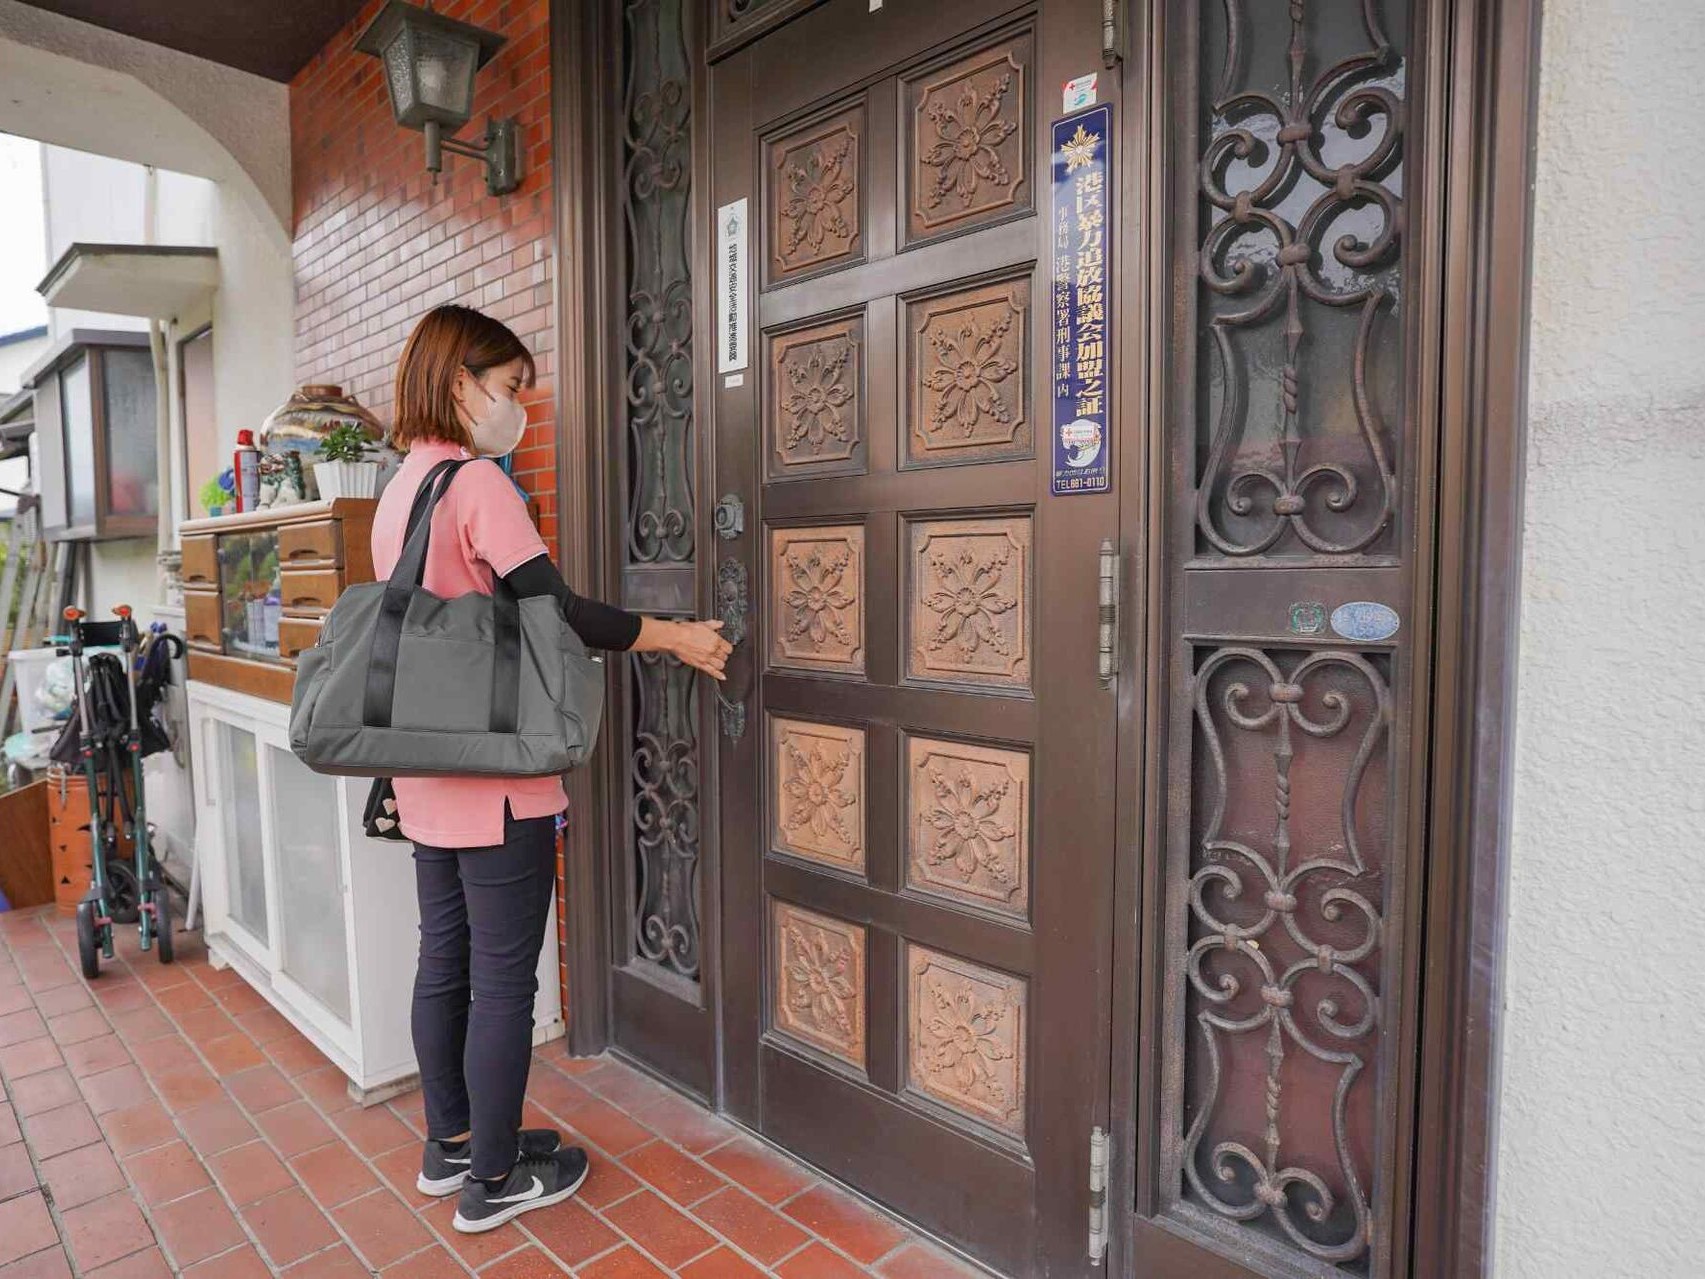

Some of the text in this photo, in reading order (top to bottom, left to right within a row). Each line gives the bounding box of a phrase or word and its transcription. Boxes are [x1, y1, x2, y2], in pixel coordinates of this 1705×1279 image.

[1076, 171, 1103, 417] 港区暴力追放協議会加盟之証
